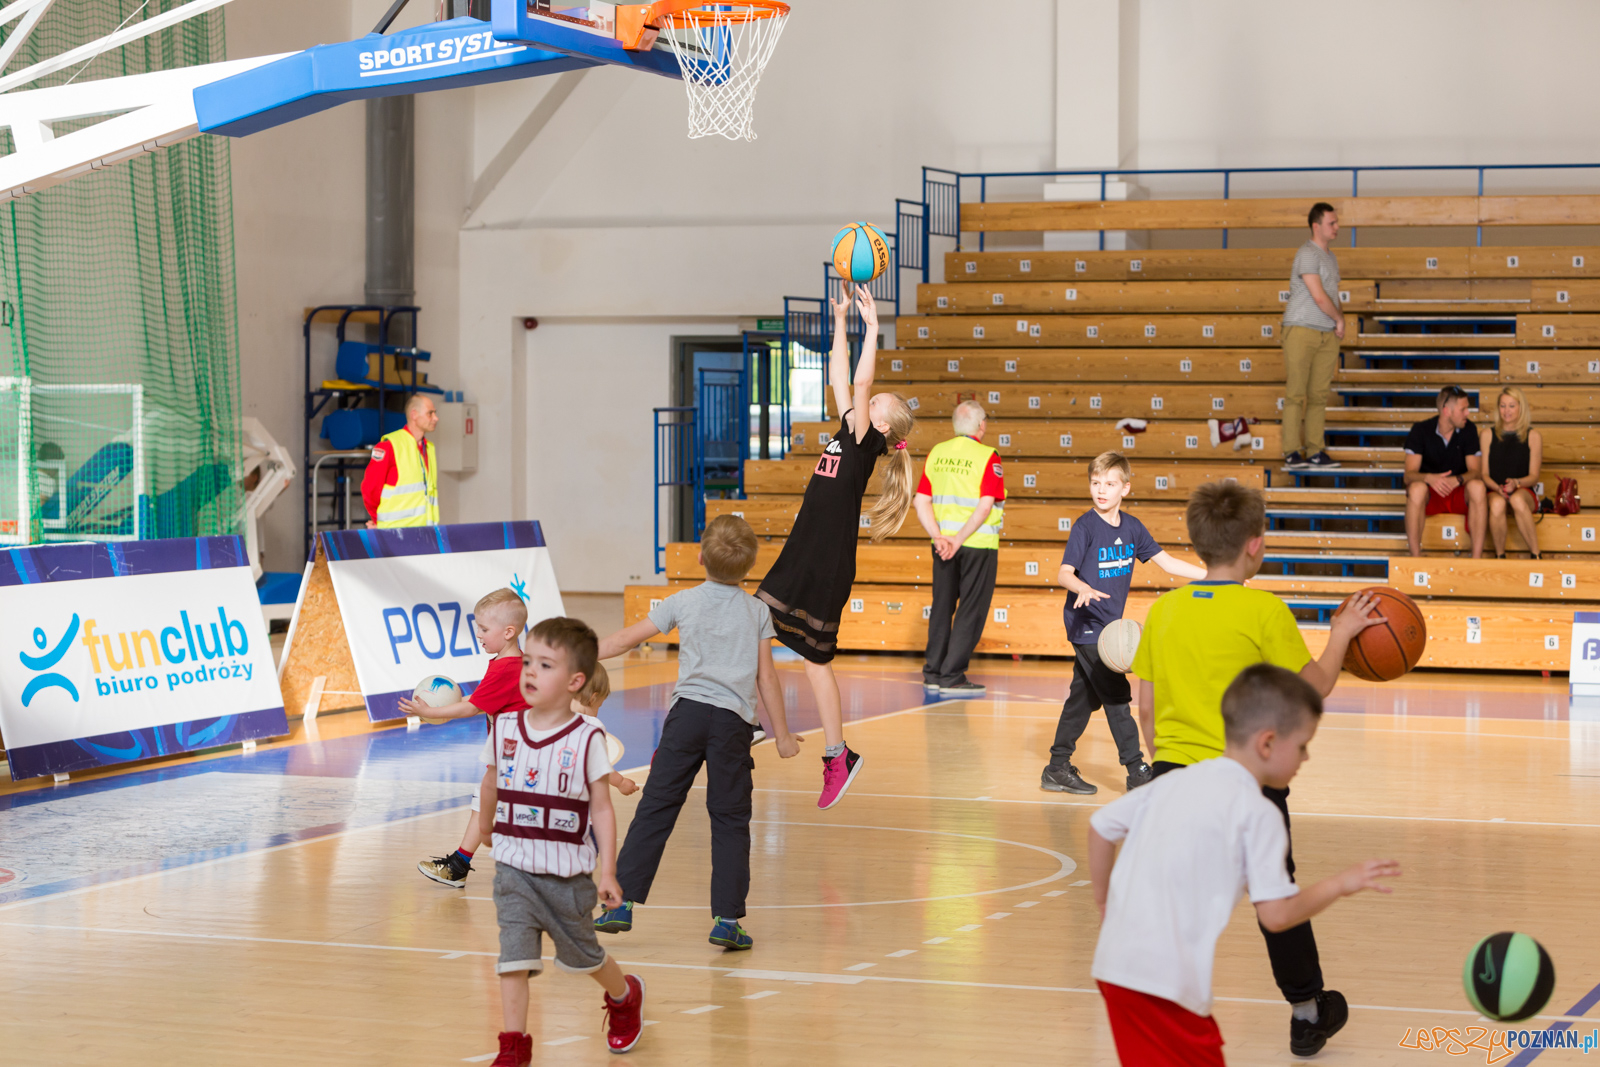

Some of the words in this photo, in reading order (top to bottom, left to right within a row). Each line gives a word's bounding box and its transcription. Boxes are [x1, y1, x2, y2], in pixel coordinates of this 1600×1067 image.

[359, 42, 436, 70] SPORT
[438, 31, 514, 62] SYST
[967, 263, 975, 271] 13
[1021, 261, 1030, 269] 11
[1131, 261, 1141, 270] 12
[1427, 259, 1437, 268] 10
[938, 298, 947, 306] 16
[994, 295, 1003, 303] 15
[919, 328, 928, 337] 16
[974, 328, 984, 336] 14
[1031, 327, 1039, 335] 14
[1088, 327, 1097, 336] 13
[1146, 327, 1155, 336] 12
[1204, 327, 1213, 336] 11
[1263, 327, 1272, 336] 10
[893, 361, 902, 370] 16
[949, 361, 958, 371] 15
[1006, 362, 1016, 371] 14
[1182, 362, 1191, 370] 11
[1241, 361, 1250, 371] 10
[1591, 362, 1597, 372] 7
[990, 393, 999, 402] 14
[909, 399, 918, 408] 15
[1030, 398, 1039, 407] 13
[1091, 398, 1101, 407] 12
[1153, 399, 1162, 408] 11
[1214, 399, 1223, 408] 10
[820, 434, 829, 442] 16
[1000, 436, 1010, 445] 13
[1061, 436, 1071, 446] 12
[1125, 438, 1134, 447] 11
[1187, 437, 1197, 447] 10
[933, 457, 973, 468] JOKER
[933, 466, 969, 475] SECURITY
[1025, 476, 1035, 486] 12
[1157, 478, 1167, 488] 10
[1061, 520, 1069, 528] 11
[1028, 564, 1038, 573] 11
[852, 601, 863, 610] 13
[996, 611, 1006, 620] 11
[81, 606, 249, 674] funclub
[95, 676, 159, 696] biuro
[166, 660, 253, 692] podróży
[558, 772, 569, 793] 0
